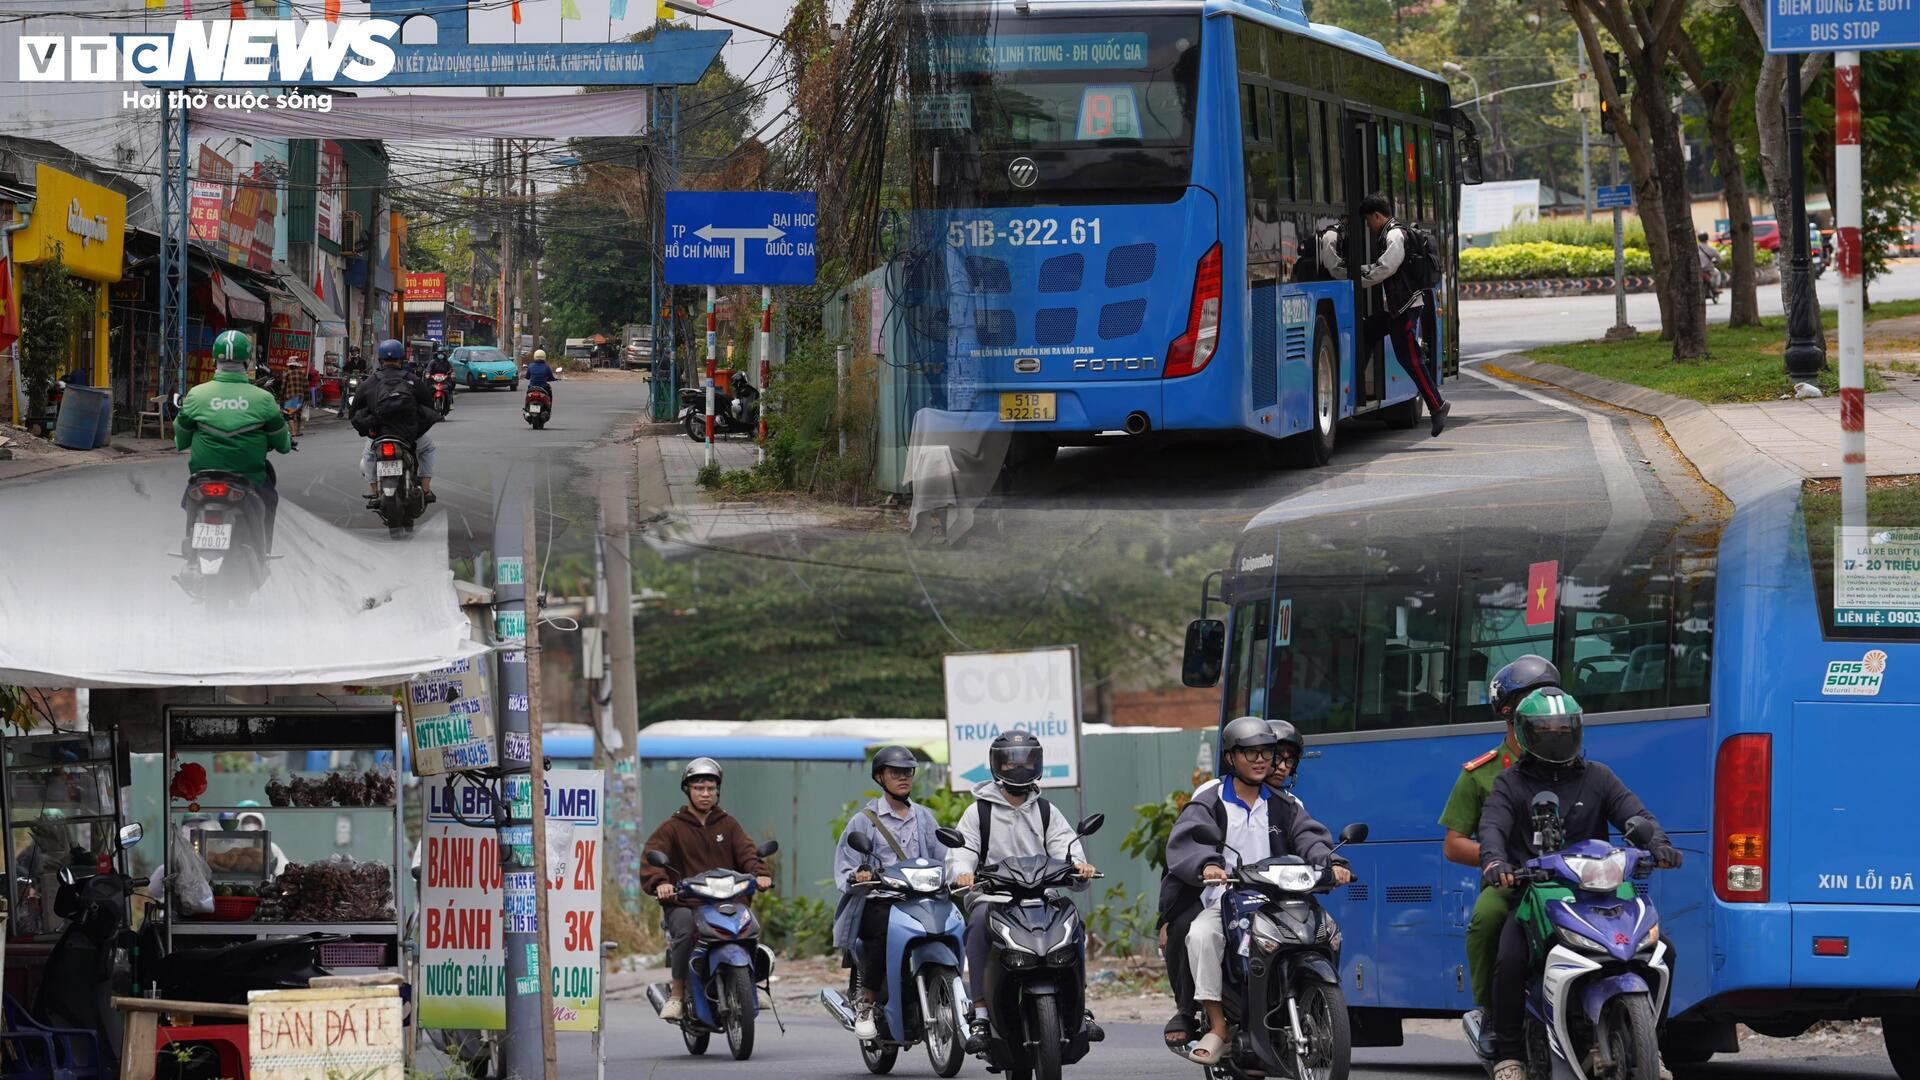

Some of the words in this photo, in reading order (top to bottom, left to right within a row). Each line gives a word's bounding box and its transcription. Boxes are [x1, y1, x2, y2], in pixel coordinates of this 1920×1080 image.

[1811, 23, 1839, 41] BUS
[1843, 21, 1880, 40] STOP
[1000, 45, 1024, 63] LINH
[1027, 45, 1063, 62] TRUNG
[1072, 45, 1088, 61] ĐH
[1091, 38, 1120, 64] QUỐC
[1123, 44, 1141, 60] GIA
[474, 55, 490, 72] GIA
[192, 207, 204, 219] XE
[206, 207, 219, 220] GA
[773, 213, 791, 229] ĐẠI
[794, 213, 815, 229] HỌC
[672, 225, 686, 238] TP
[949, 218, 1101, 247] 51B-322.61
[665, 240, 679, 258] HỒ
[683, 242, 700, 258] CHÍ
[703, 245, 730, 258] MINH
[765, 238, 793, 256] QUỐC
[797, 243, 815, 256] GIA
[1073, 357, 1157, 372] FOTON
[210, 396, 249, 410] Grab
[1015, 394, 1039, 406] 51B
[1006, 408, 1049, 420] 322.61
[1844, 560, 1856, 570] 17
[1866, 560, 1882, 570] 20
[1838, 611, 1863, 623] LIÊN
[1866, 611, 1885, 626] HỆ:
[1830, 663, 1862, 673] GAS
[1826, 676, 1880, 686] SOUTH
[955, 720, 1000, 741] TRƯA
[559, 789, 595, 817] MAI
[428, 826, 473, 888] BÁNH
[574, 840, 596, 890] 2K
[1818, 874, 1848, 889] XIN
[1856, 869, 1882, 890] LỖI
[1890, 873, 1914, 890] ĐÃ
[426, 899, 491, 950] BÁNH
[514, 916, 525, 932] 115
[564, 911, 594, 951] 3K
[427, 958, 462, 996] NƯỚC
[467, 955, 493, 996] GIẢI
[564, 966, 593, 1005] LOẠI
[260, 1006, 314, 1050] BÁN
